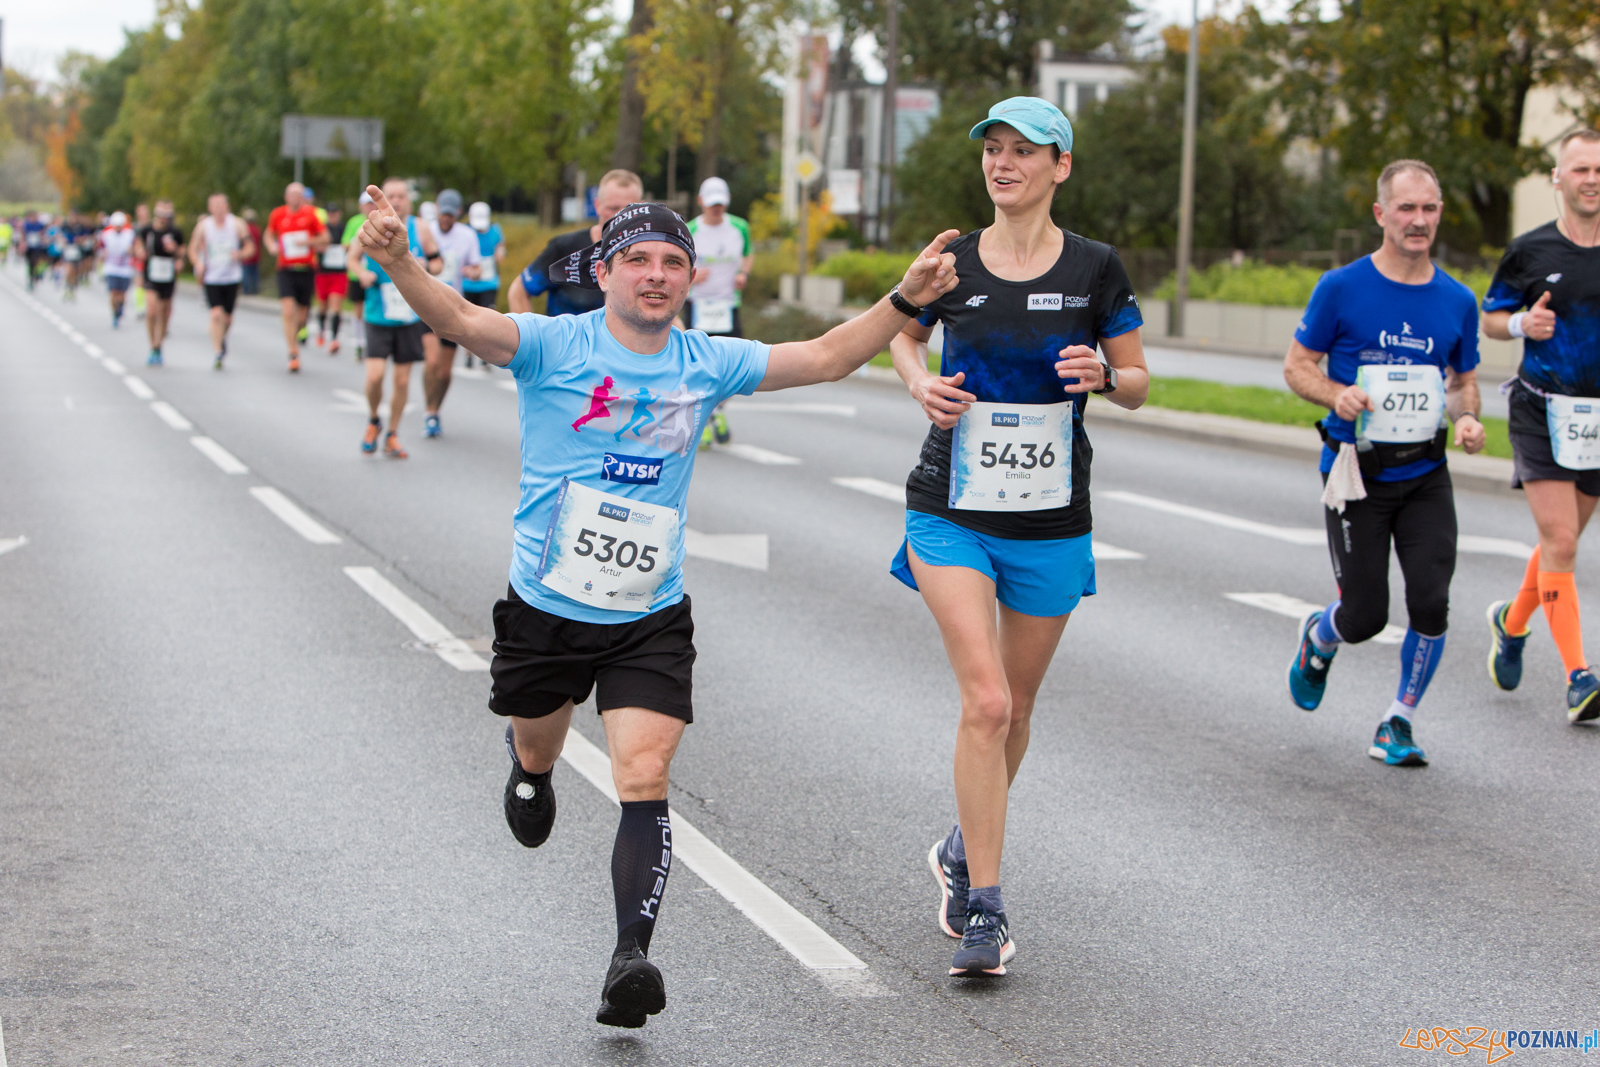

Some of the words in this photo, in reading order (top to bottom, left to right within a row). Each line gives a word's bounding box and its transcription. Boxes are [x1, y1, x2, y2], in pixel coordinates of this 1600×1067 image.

[965, 295, 988, 307] 4F
[1031, 298, 1042, 306] 18.
[1043, 297, 1060, 306] PKO
[1382, 392, 1429, 412] 6712
[993, 416, 1002, 424] 18.
[1003, 416, 1018, 424] PKO
[979, 441, 1056, 470] 5436
[614, 461, 662, 479] JYSK
[1005, 471, 1032, 480] Emilia
[602, 506, 612, 515] 18.
[611, 508, 628, 519] PKO
[630, 516, 653, 526] maraton
[573, 528, 659, 573] 5305
[599, 565, 623, 578] Artur
[640, 816, 672, 918] Kalenji
